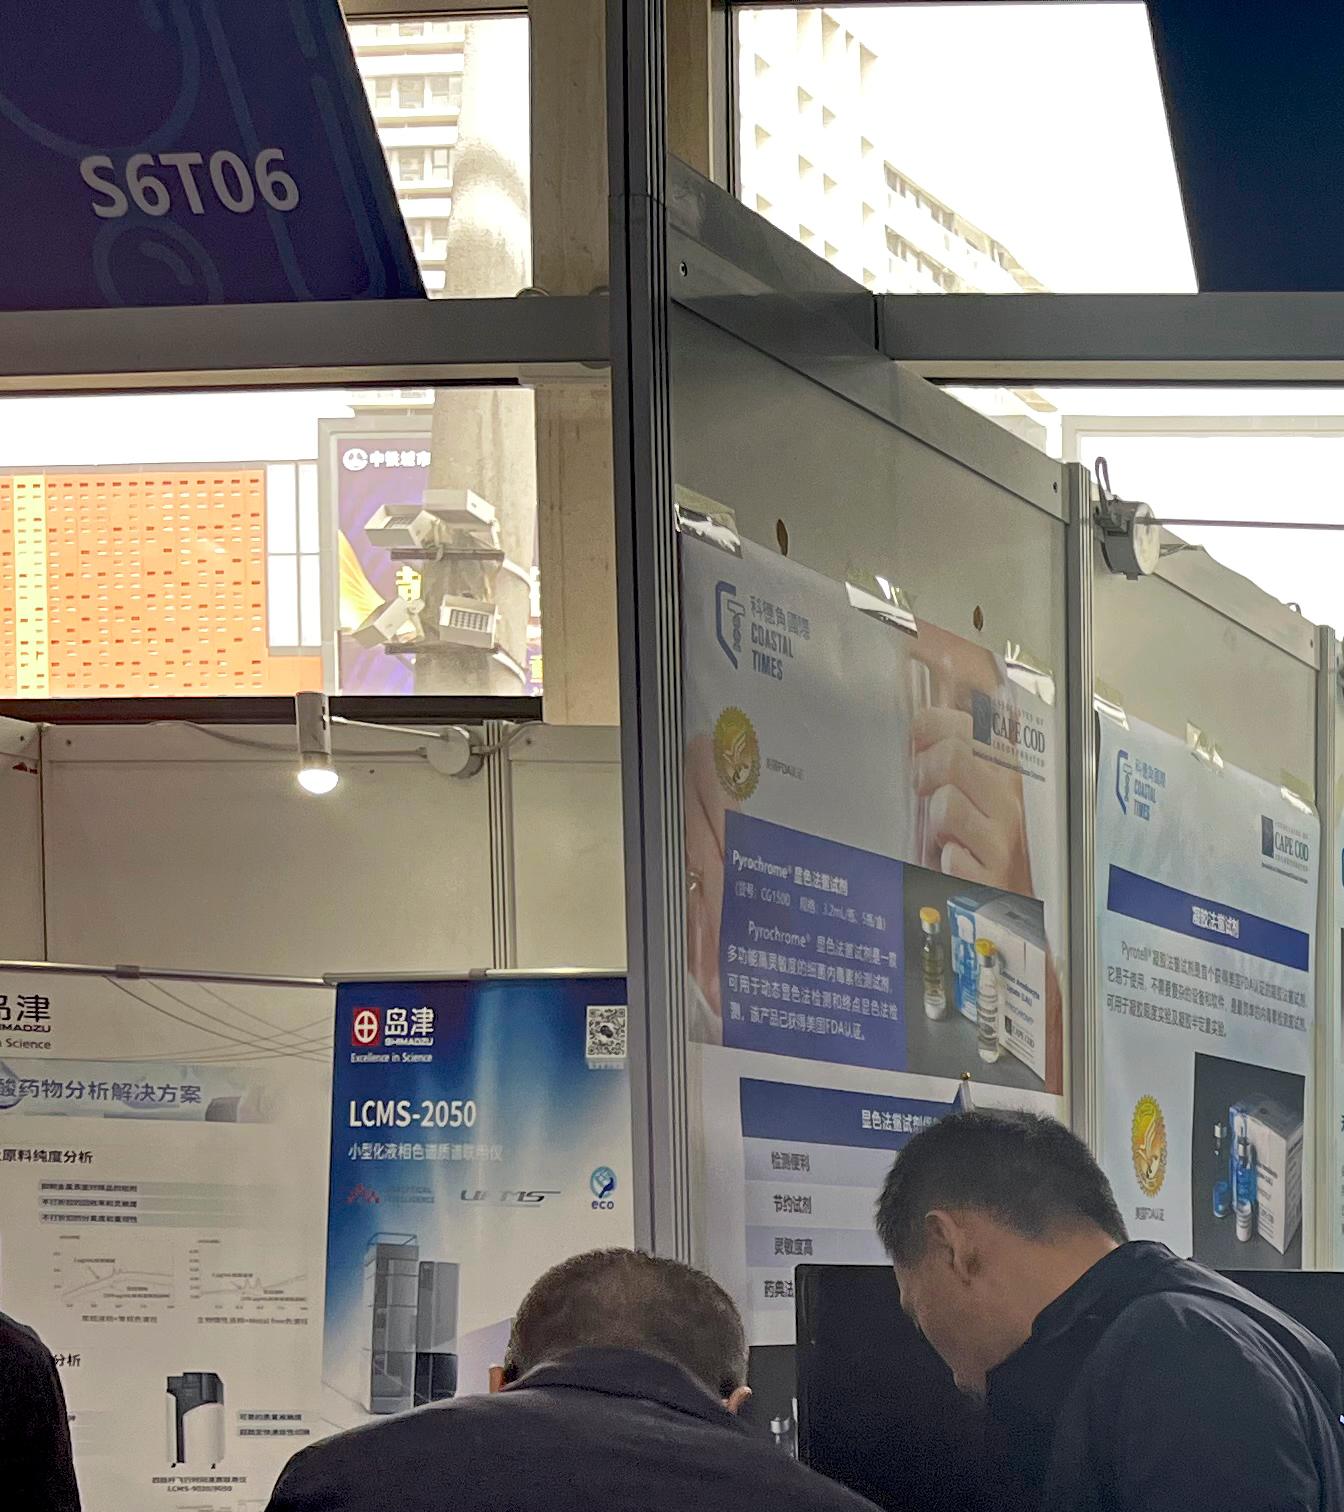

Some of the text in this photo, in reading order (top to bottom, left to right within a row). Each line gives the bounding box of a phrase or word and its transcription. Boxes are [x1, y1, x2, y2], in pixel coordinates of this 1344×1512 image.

[79, 148, 300, 218] S6T06
[751, 622, 793, 659] COASTAL
[752, 650, 783, 681] TIMES
[993, 712, 1045, 754] CAPE COD
[1274, 832, 1293, 857] CAPE
[384, 1007, 435, 1036] 岛津
[5, 1037, 51, 1050] Science
[350, 1052, 433, 1064] Excellence in Science
[349, 1100, 477, 1128] LCMS-2050
[771, 1151, 811, 1172] 检测便利
[591, 1200, 615, 1210] eco
[773, 1194, 812, 1214] 节约试剂
[774, 1237, 813, 1256] 灵敏度高
